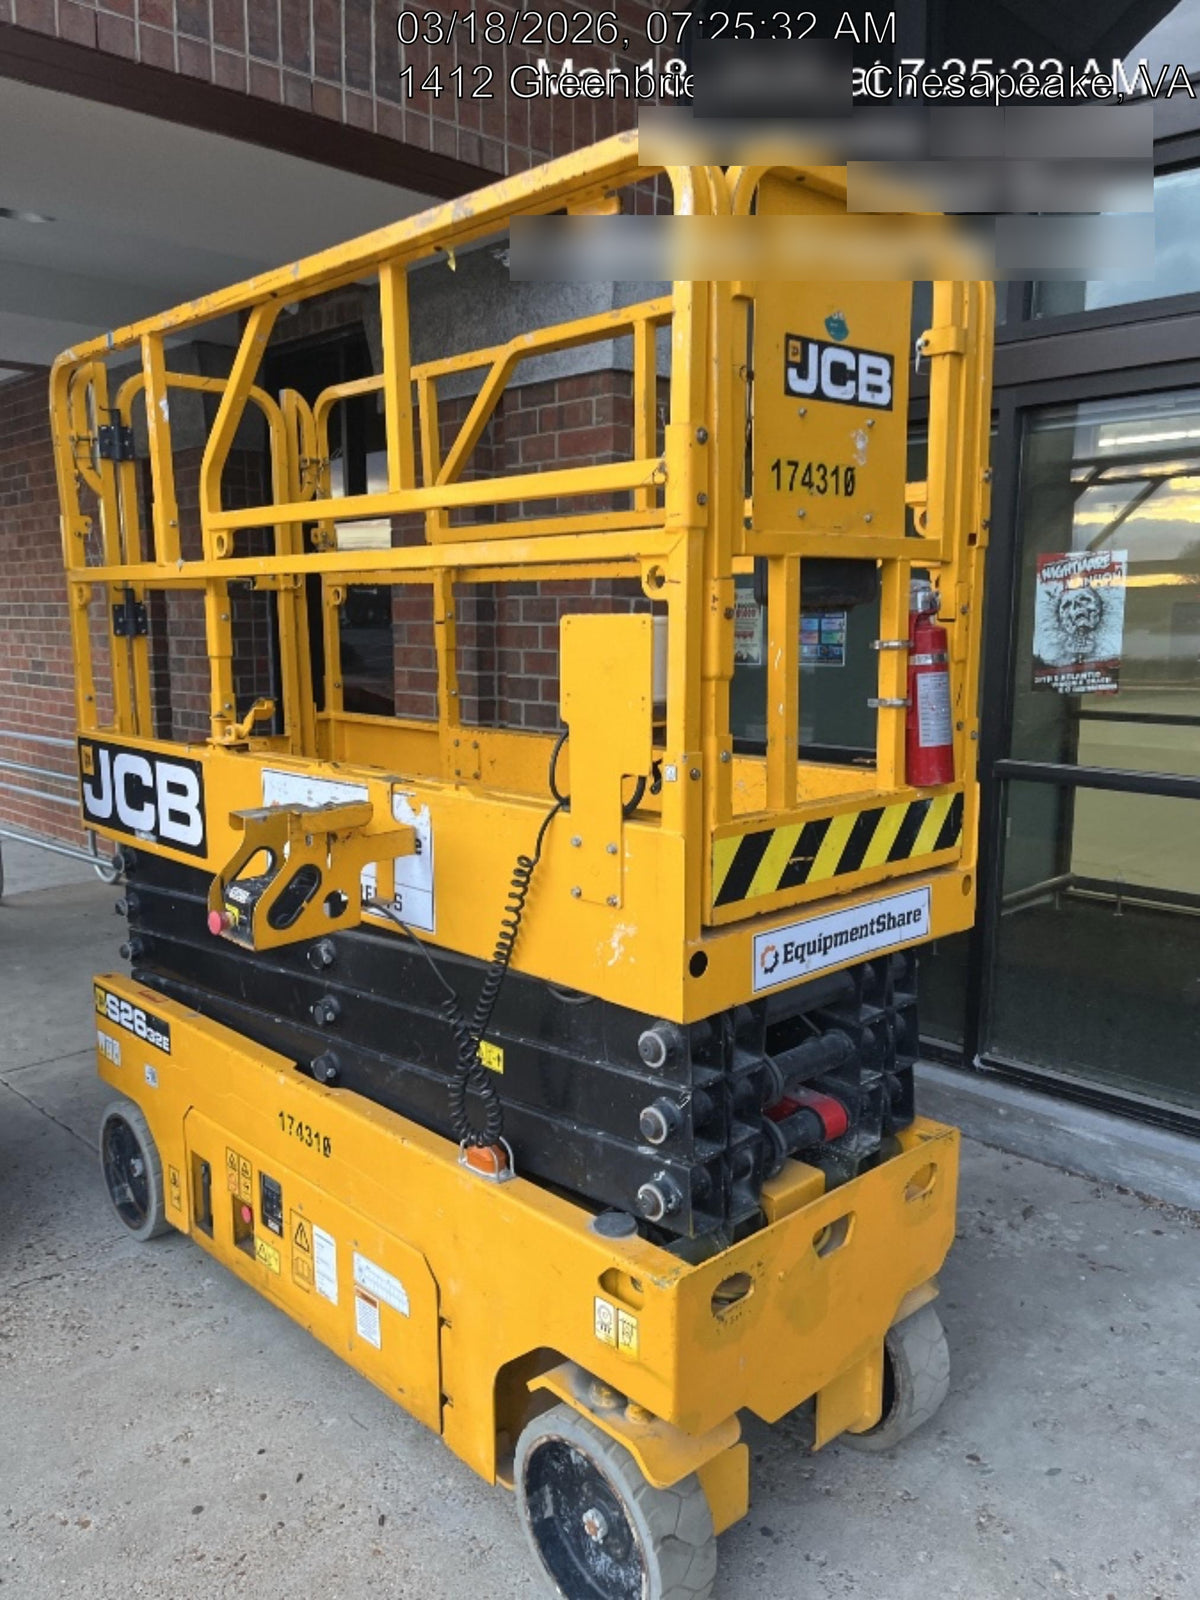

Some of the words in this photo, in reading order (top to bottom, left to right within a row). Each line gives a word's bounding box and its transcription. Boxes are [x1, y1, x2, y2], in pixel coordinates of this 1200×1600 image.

[787, 342, 893, 406] JCB
[83, 748, 204, 847] JCB
[782, 907, 922, 965] EquipmentShare
